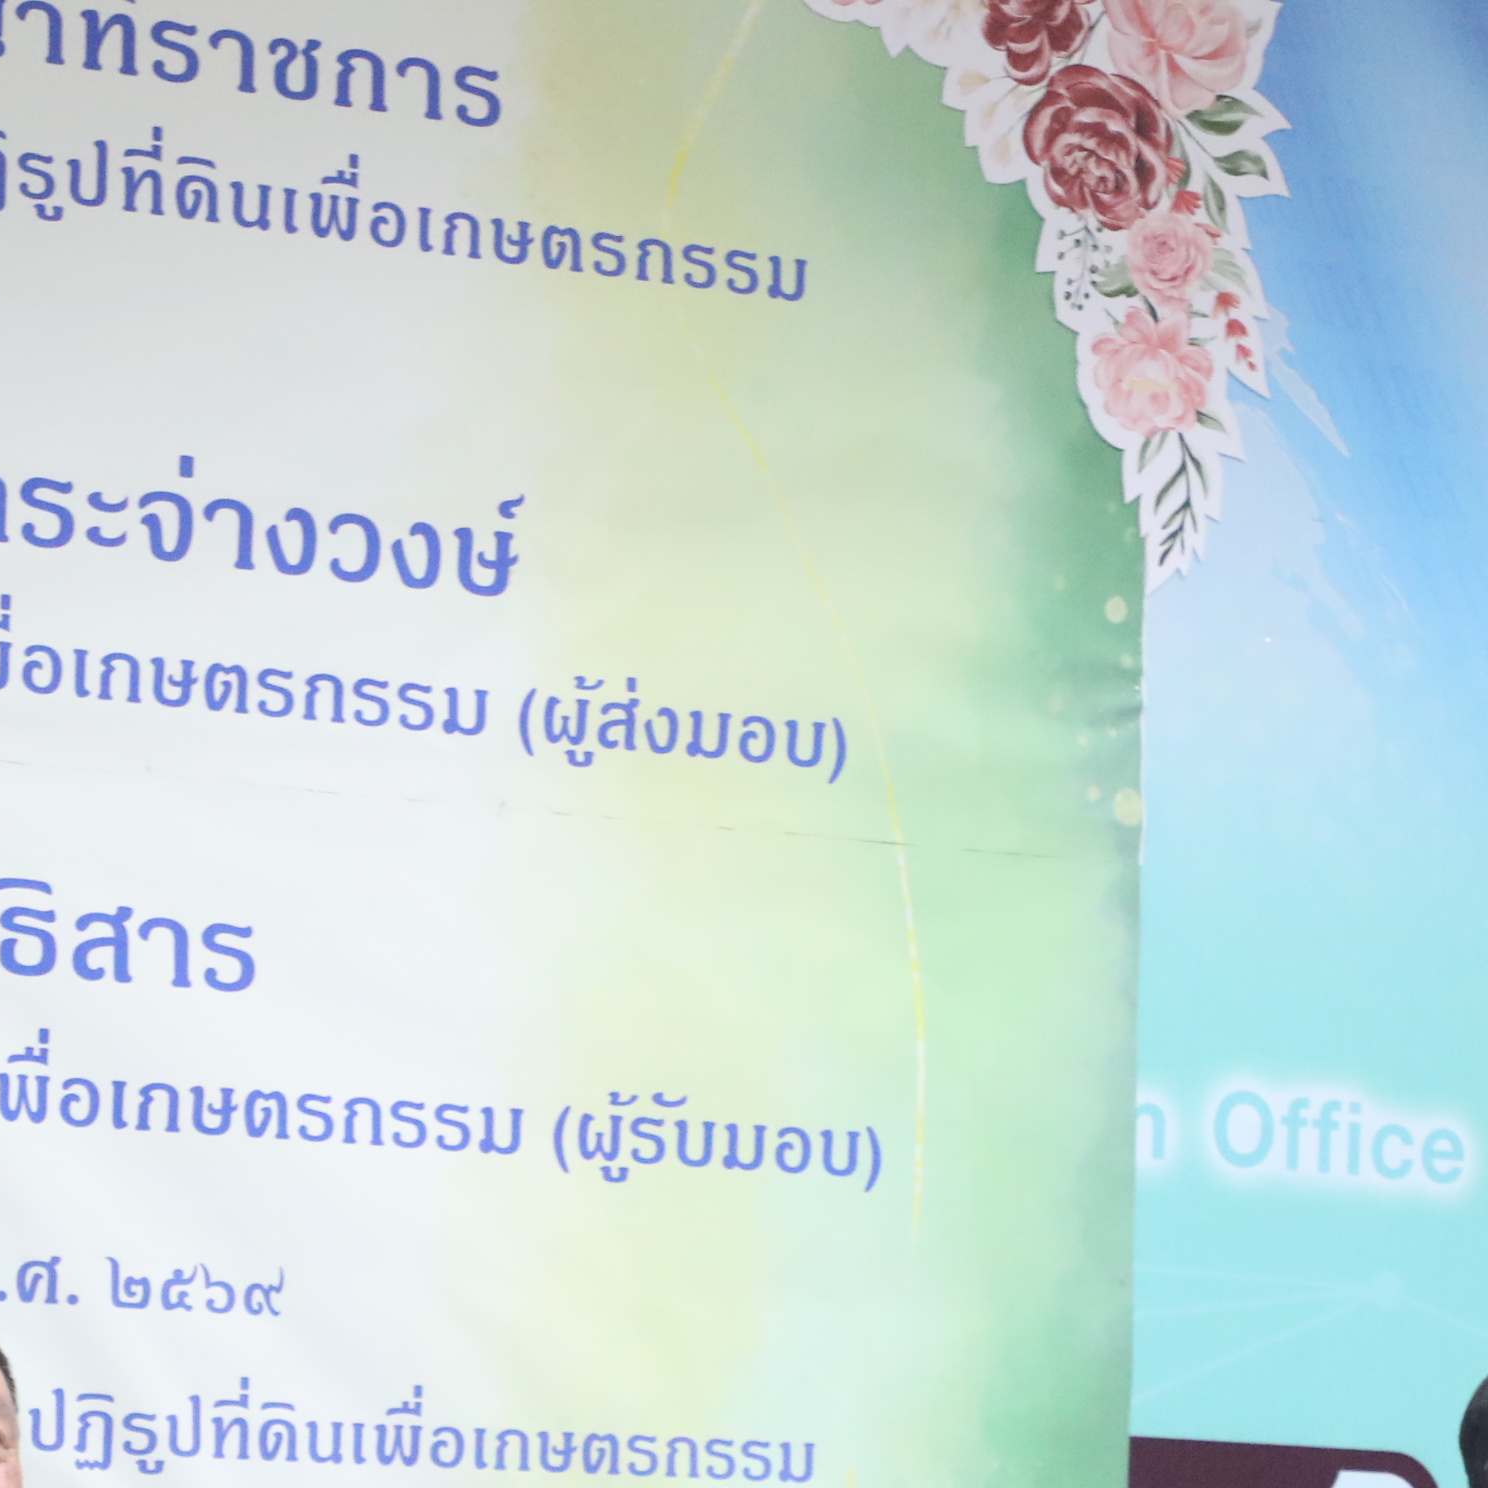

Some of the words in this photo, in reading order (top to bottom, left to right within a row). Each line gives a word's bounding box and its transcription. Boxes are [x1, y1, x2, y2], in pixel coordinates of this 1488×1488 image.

[518, 676, 847, 783] (ผู้ส่งมอบ)
[553, 1092, 882, 1192] (ผู้รับมอบ)
[1215, 1090, 1465, 1184] Office
[105, 1257, 285, 1317] ๒๕๖๙
